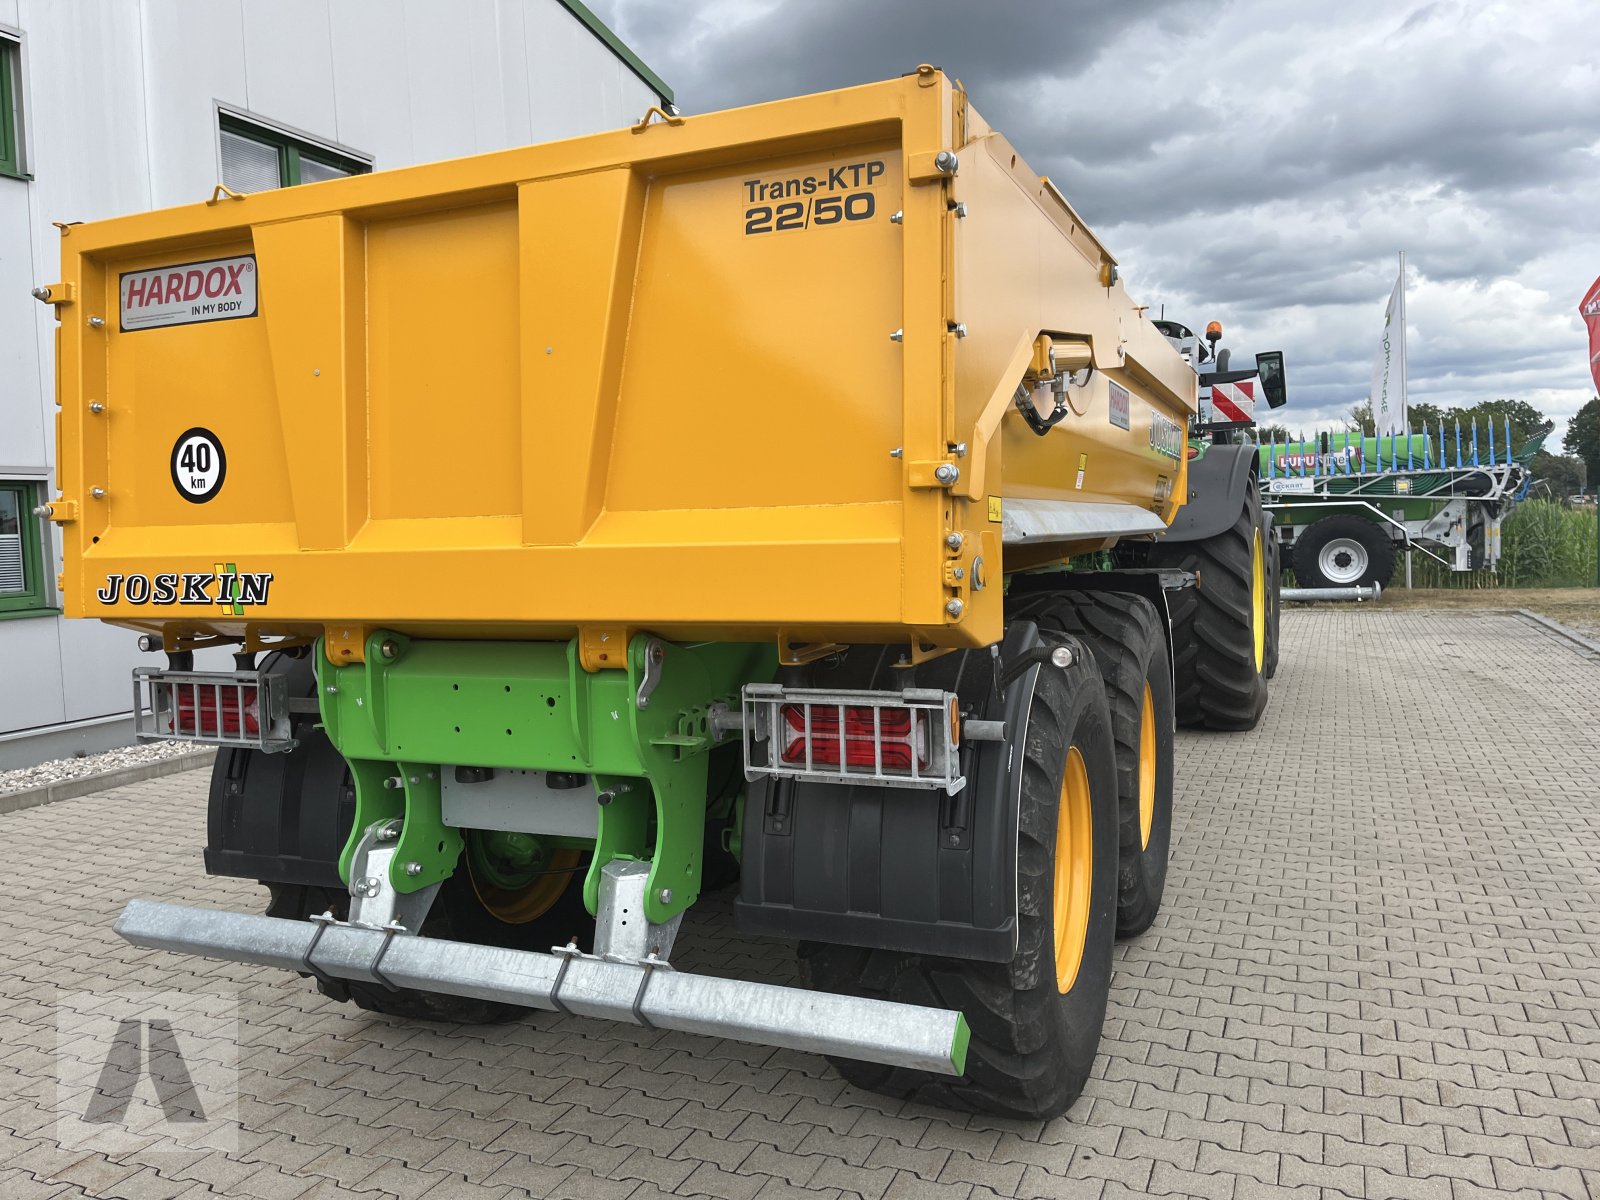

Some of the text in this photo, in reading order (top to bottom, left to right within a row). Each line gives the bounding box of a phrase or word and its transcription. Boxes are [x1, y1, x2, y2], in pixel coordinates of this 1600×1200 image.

[744, 160, 885, 203] Trans-KTP
[745, 192, 876, 236] 22/50
[191, 300, 243, 317] IN MY BODY
[180, 442, 212, 473] 40
[190, 475, 206, 489] km
[96, 571, 274, 606] JOSKIN
